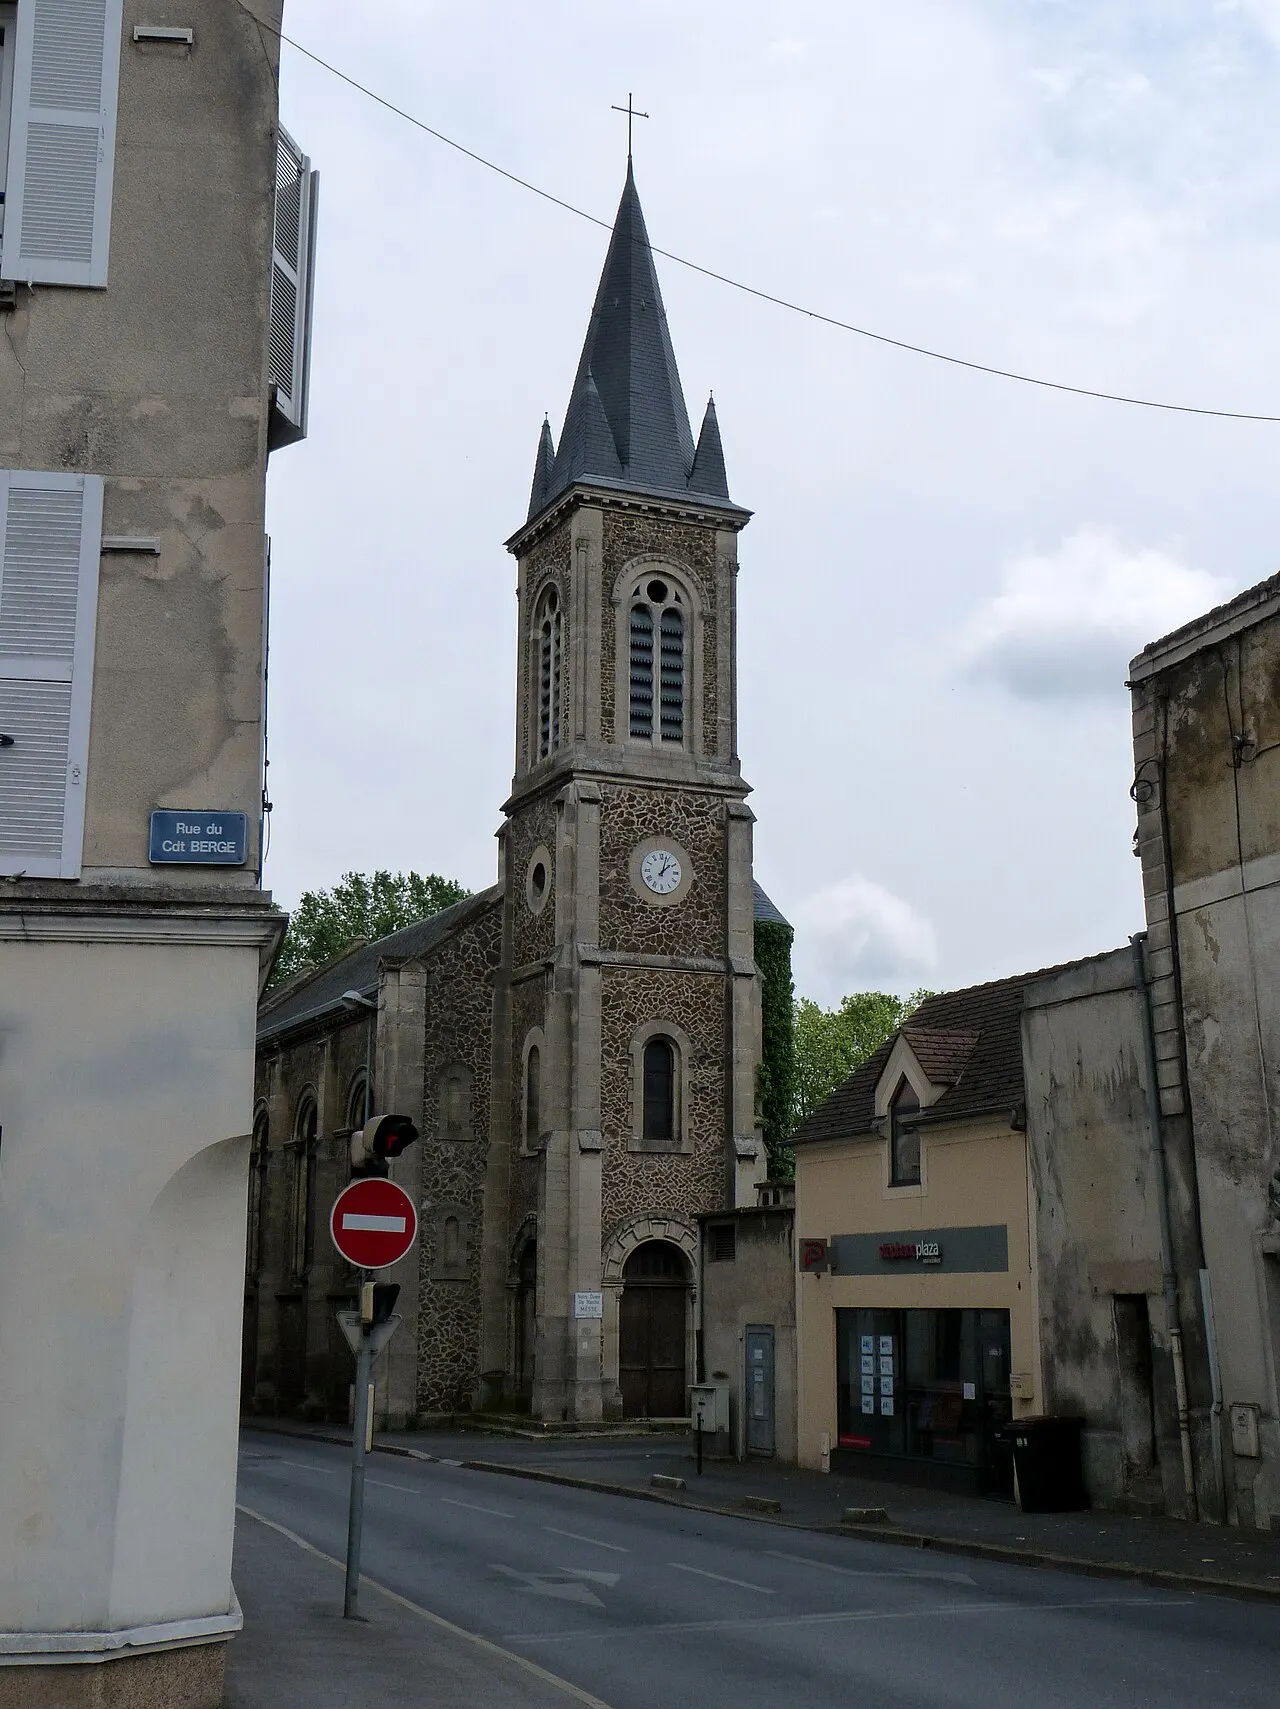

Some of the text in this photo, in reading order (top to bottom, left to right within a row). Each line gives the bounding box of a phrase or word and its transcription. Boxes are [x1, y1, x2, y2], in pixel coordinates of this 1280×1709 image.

[176, 823, 223, 835] Rue du
[162, 840, 236, 853] Cdt BERGE
[915, 1240, 939, 1260] plaza
